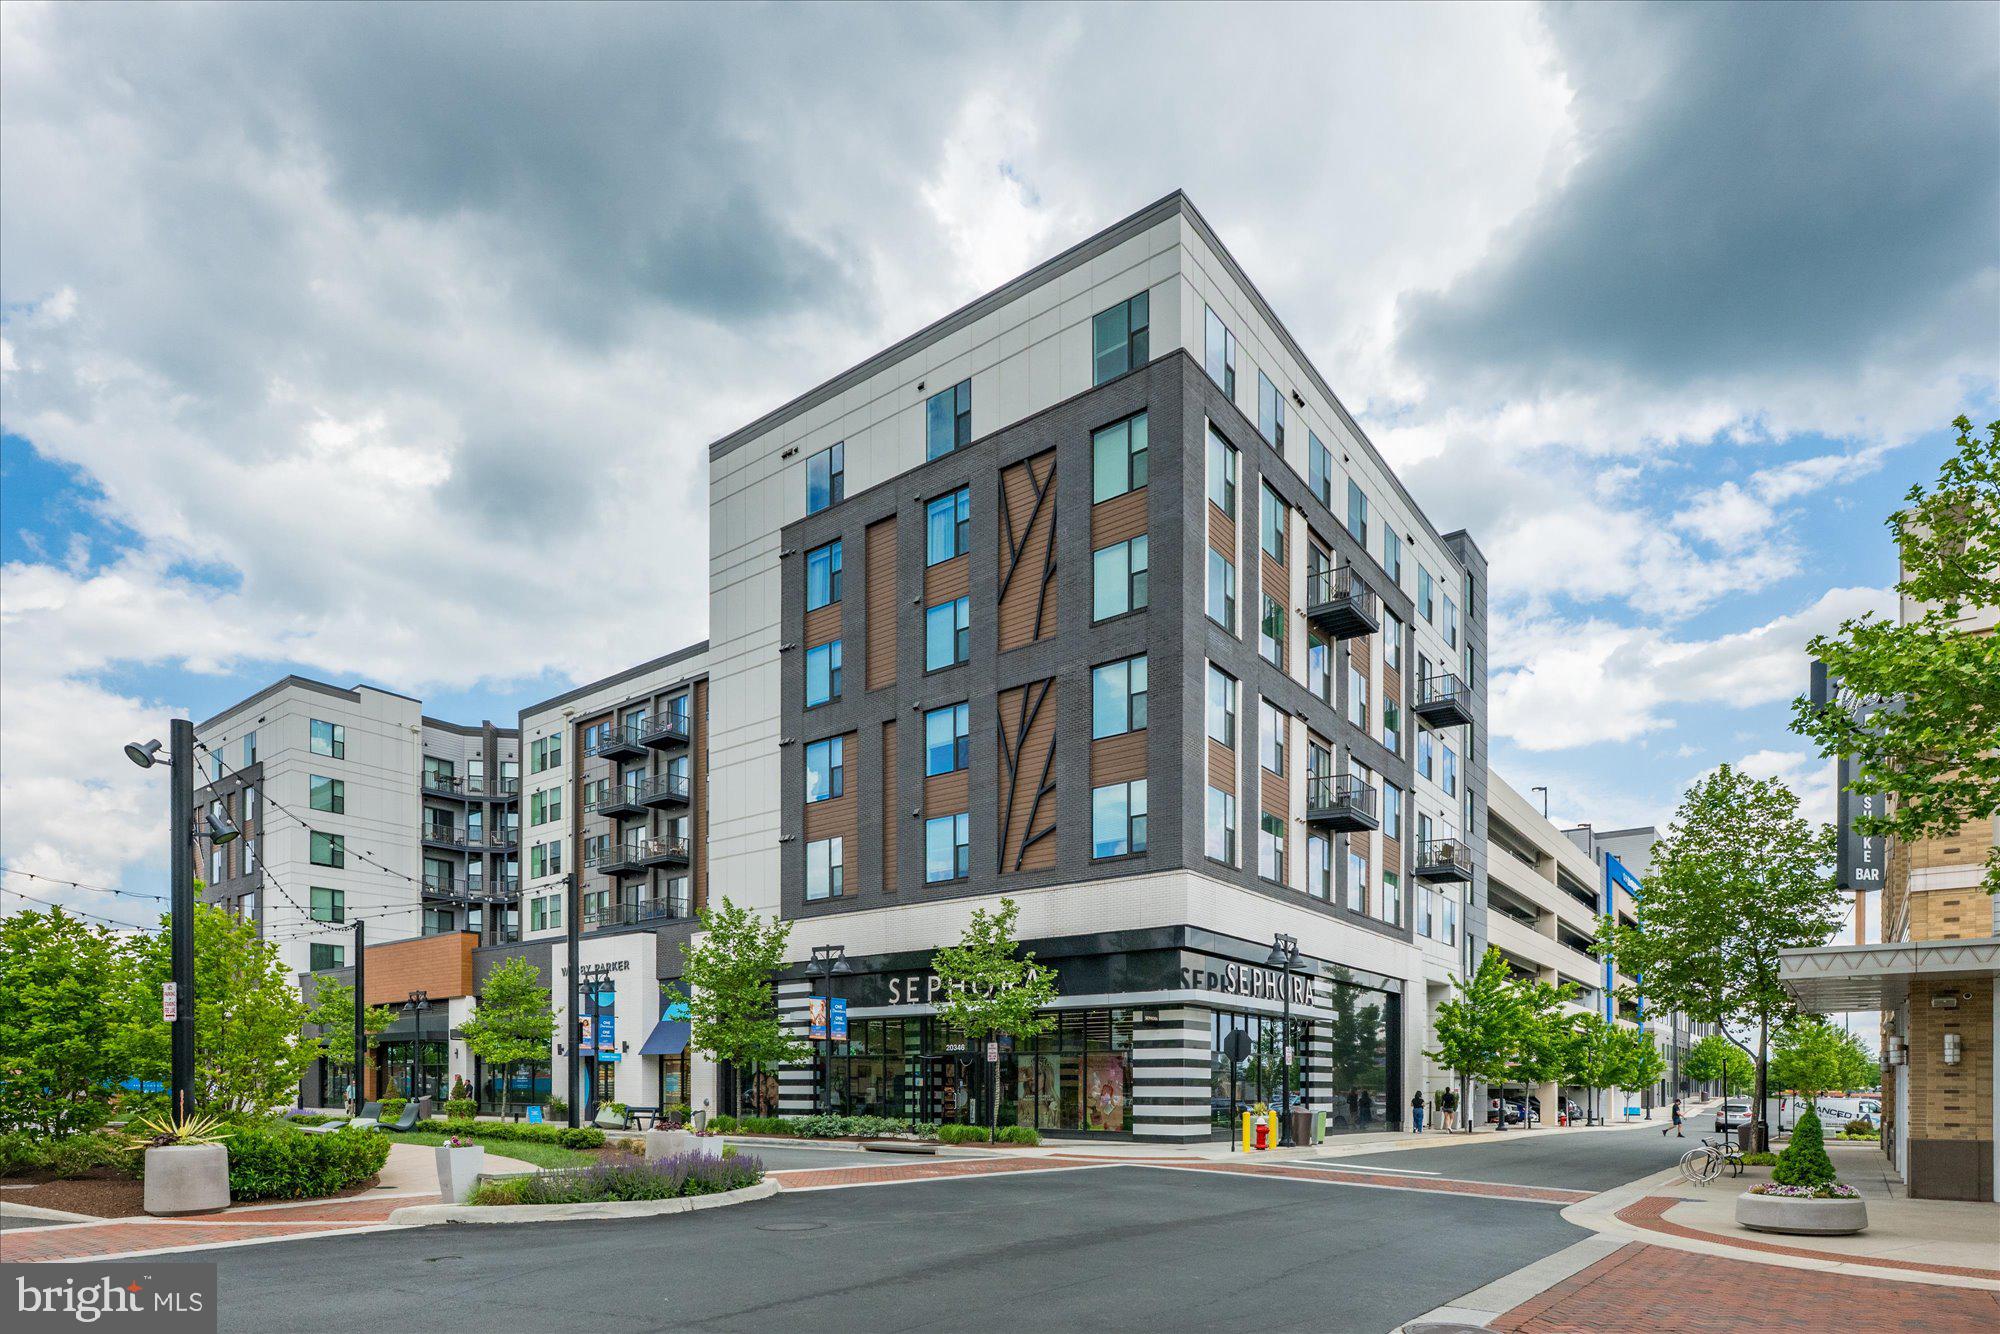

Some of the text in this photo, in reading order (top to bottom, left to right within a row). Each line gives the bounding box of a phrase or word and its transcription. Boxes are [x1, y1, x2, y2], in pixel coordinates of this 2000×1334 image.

[1855, 868, 1880, 880] BAR
[561, 960, 630, 977] WBY PARKER
[1227, 963, 1315, 1007] SEPHORA
[1794, 1101, 1852, 1119] ADANCED
